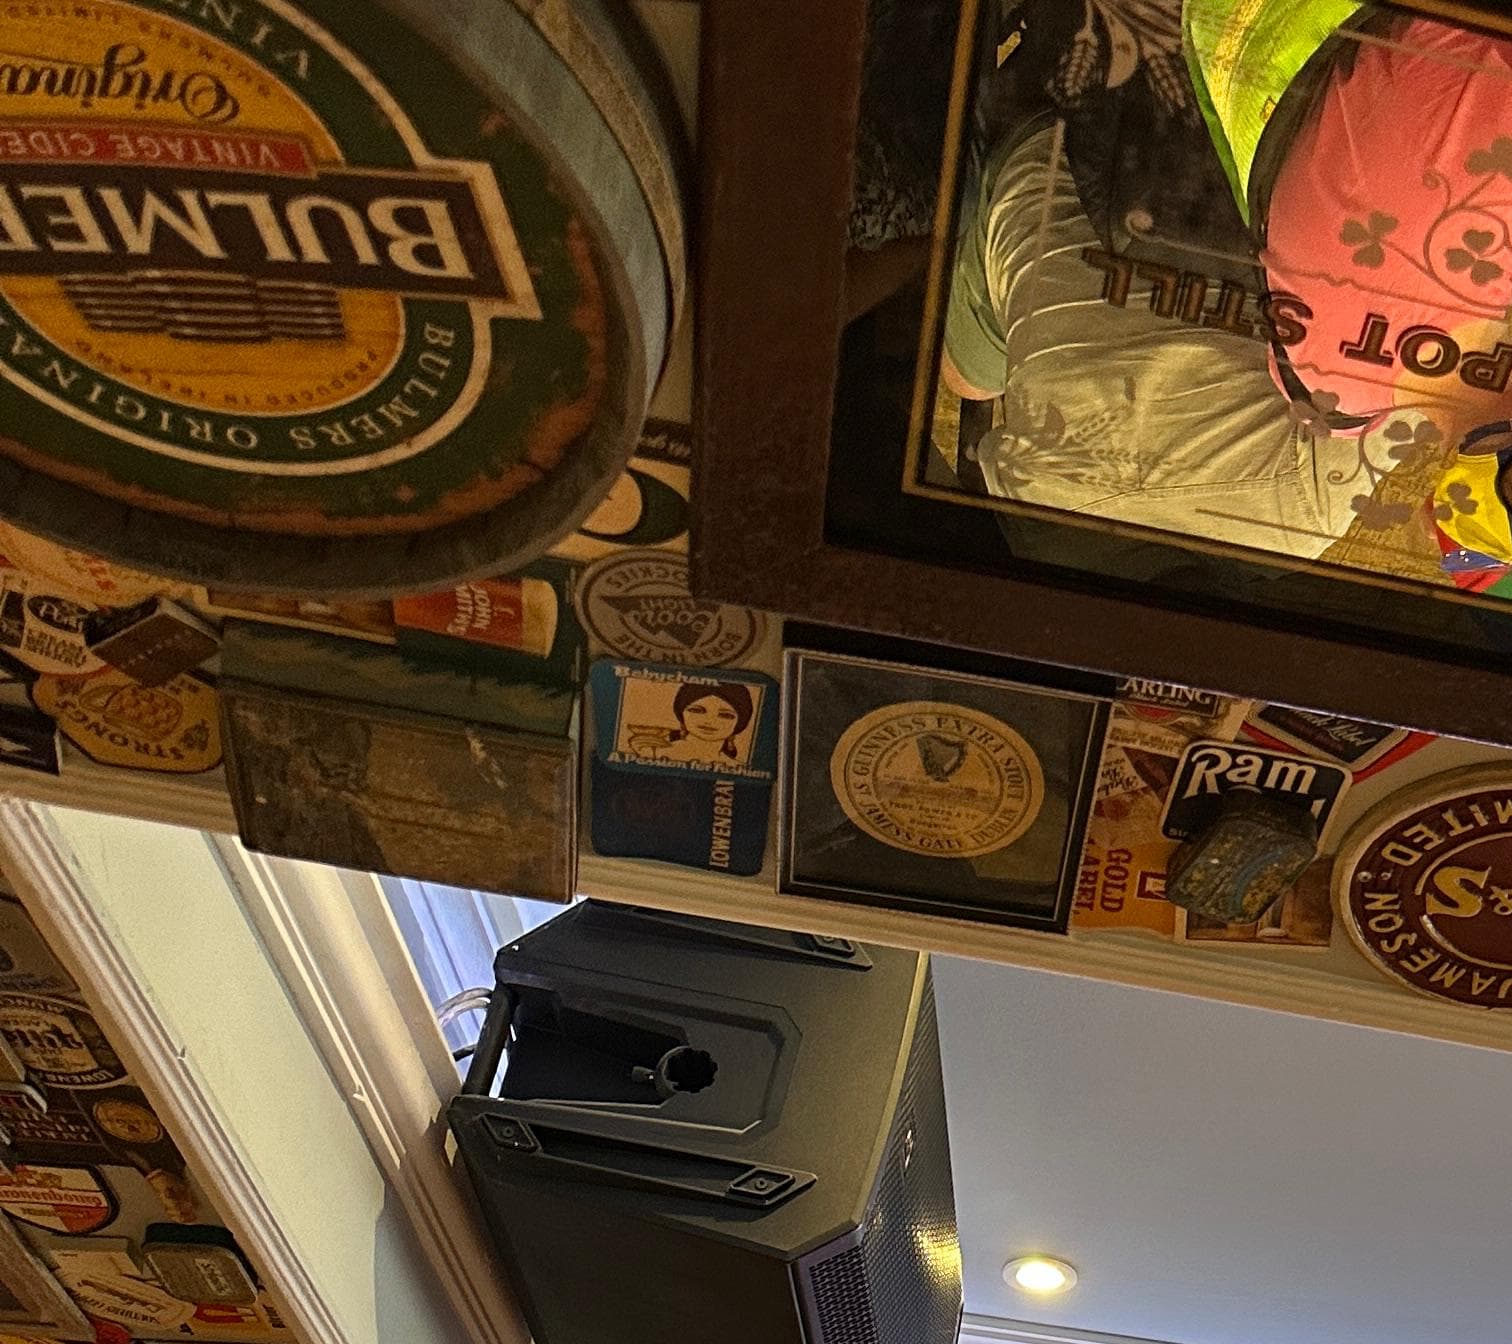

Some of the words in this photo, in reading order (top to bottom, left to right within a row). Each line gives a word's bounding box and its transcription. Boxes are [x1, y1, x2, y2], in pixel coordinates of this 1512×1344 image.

[108, 133, 281, 171] VINTAGE
[1081, 248, 1313, 349] STILL
[0, 318, 259, 451] ORIGINA
[287, 320, 457, 452] BULMERS
[605, 566, 689, 591] OCKIES
[1115, 677, 1211, 706] ARLING
[1187, 747, 1319, 797] Ram
[1074, 838, 1100, 912] ABEL
[1100, 848, 1133, 913] GOLD
